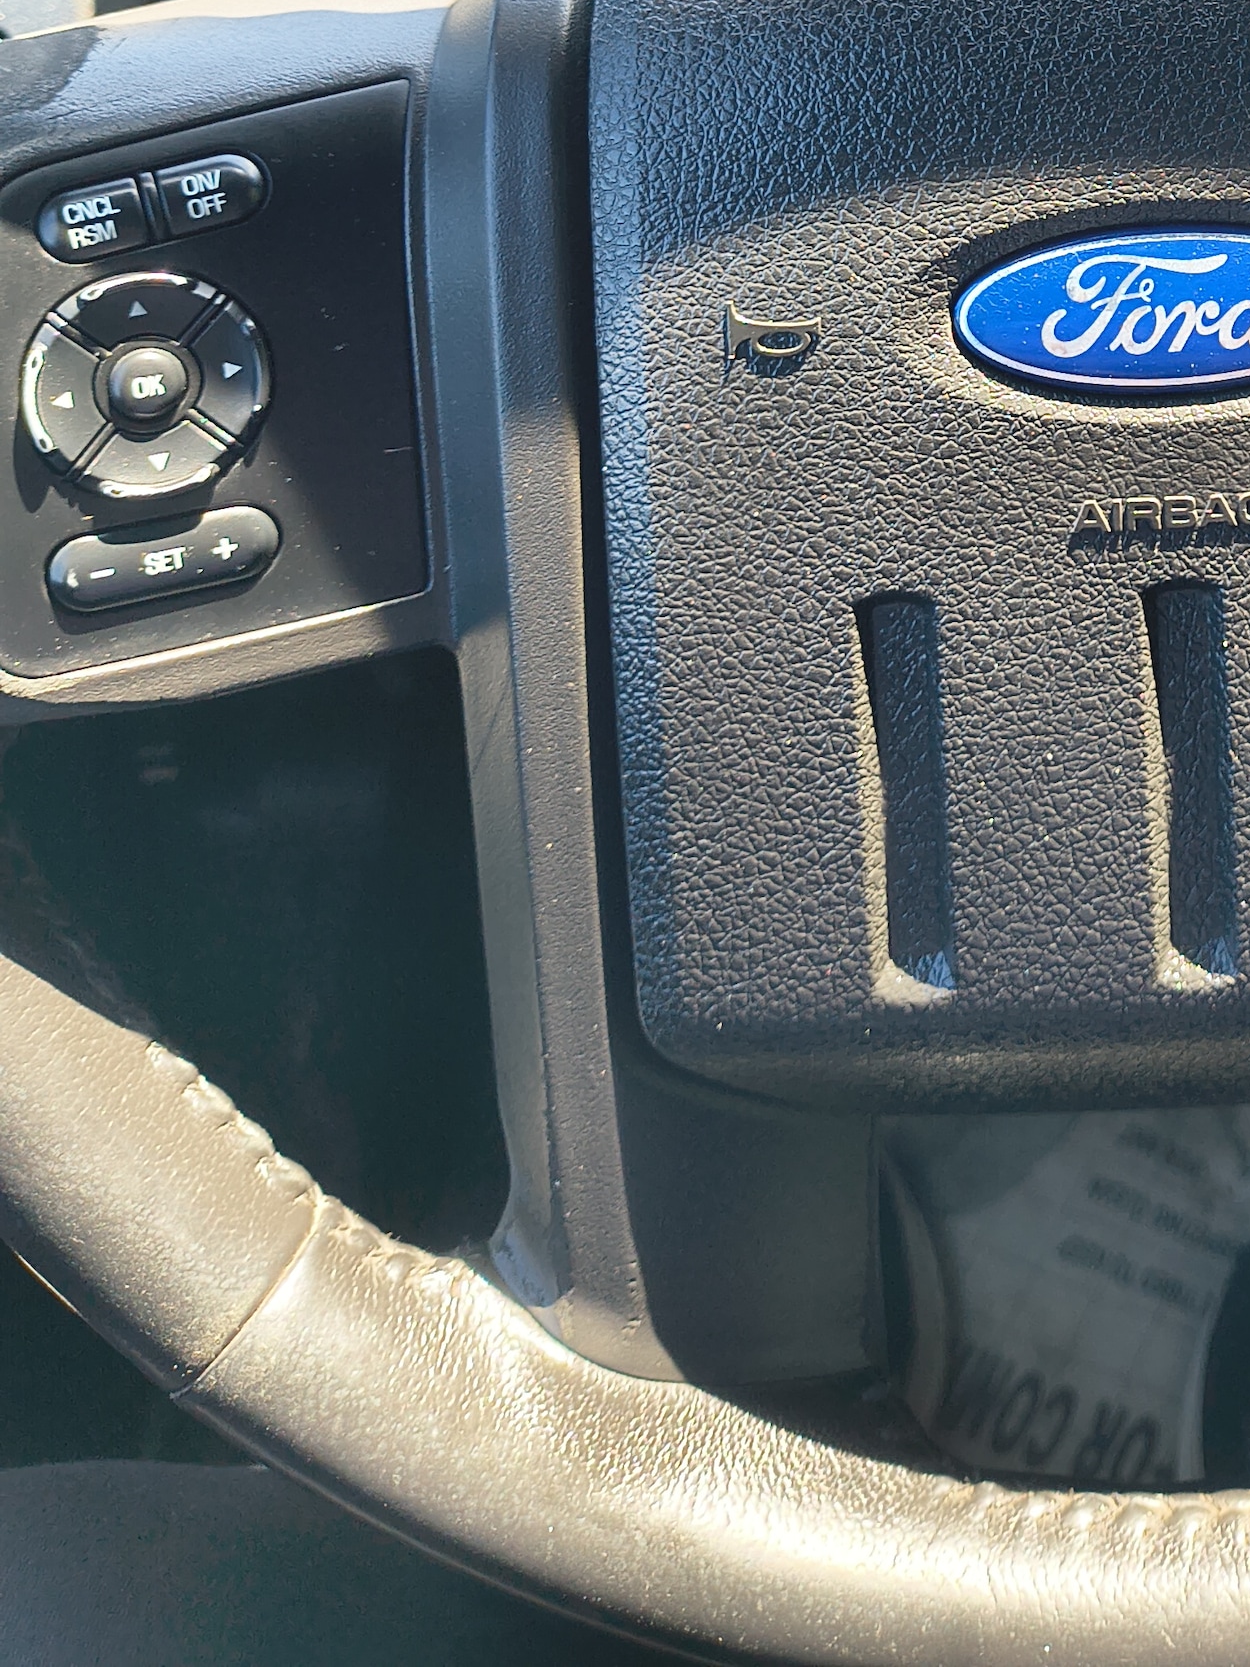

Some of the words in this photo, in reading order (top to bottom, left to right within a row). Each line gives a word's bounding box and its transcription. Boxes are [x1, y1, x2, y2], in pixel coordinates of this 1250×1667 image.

[62, 196, 121, 225] CNCL
[187, 194, 227, 219] OFF
[67, 220, 117, 249] RSM
[131, 374, 166, 399] OK
[144, 546, 187, 576] SET
